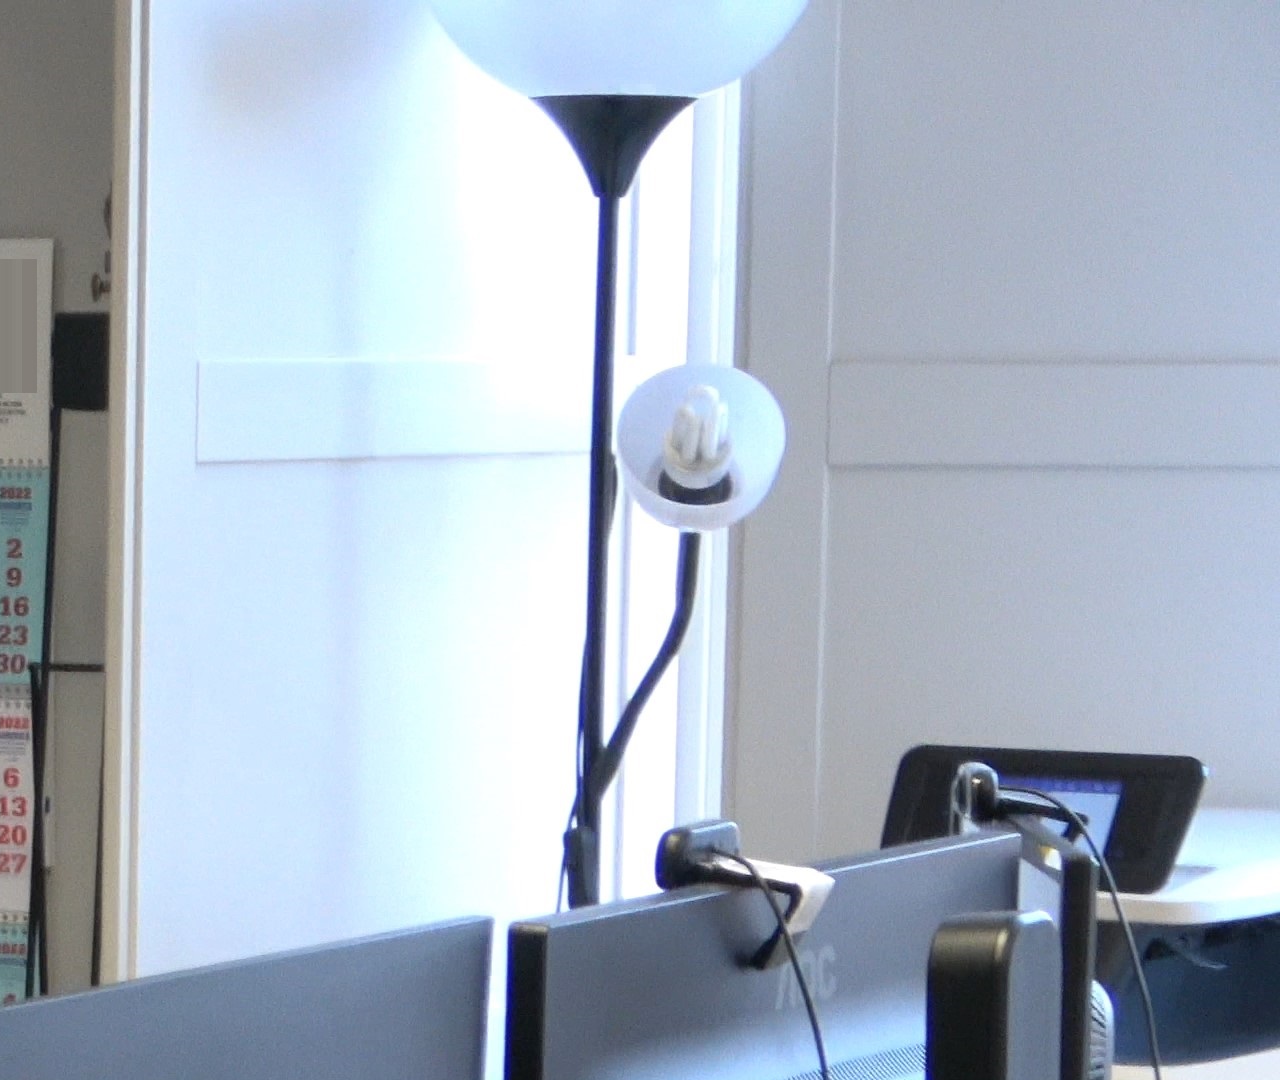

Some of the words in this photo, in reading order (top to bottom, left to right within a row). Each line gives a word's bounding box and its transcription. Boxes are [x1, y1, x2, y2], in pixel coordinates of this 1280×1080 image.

[0, 487, 31, 499] 2022
[7, 538, 22, 559] 2
[6, 567, 22, 587] 9
[0, 596, 29, 617] 16
[3, 768, 19, 788] 6
